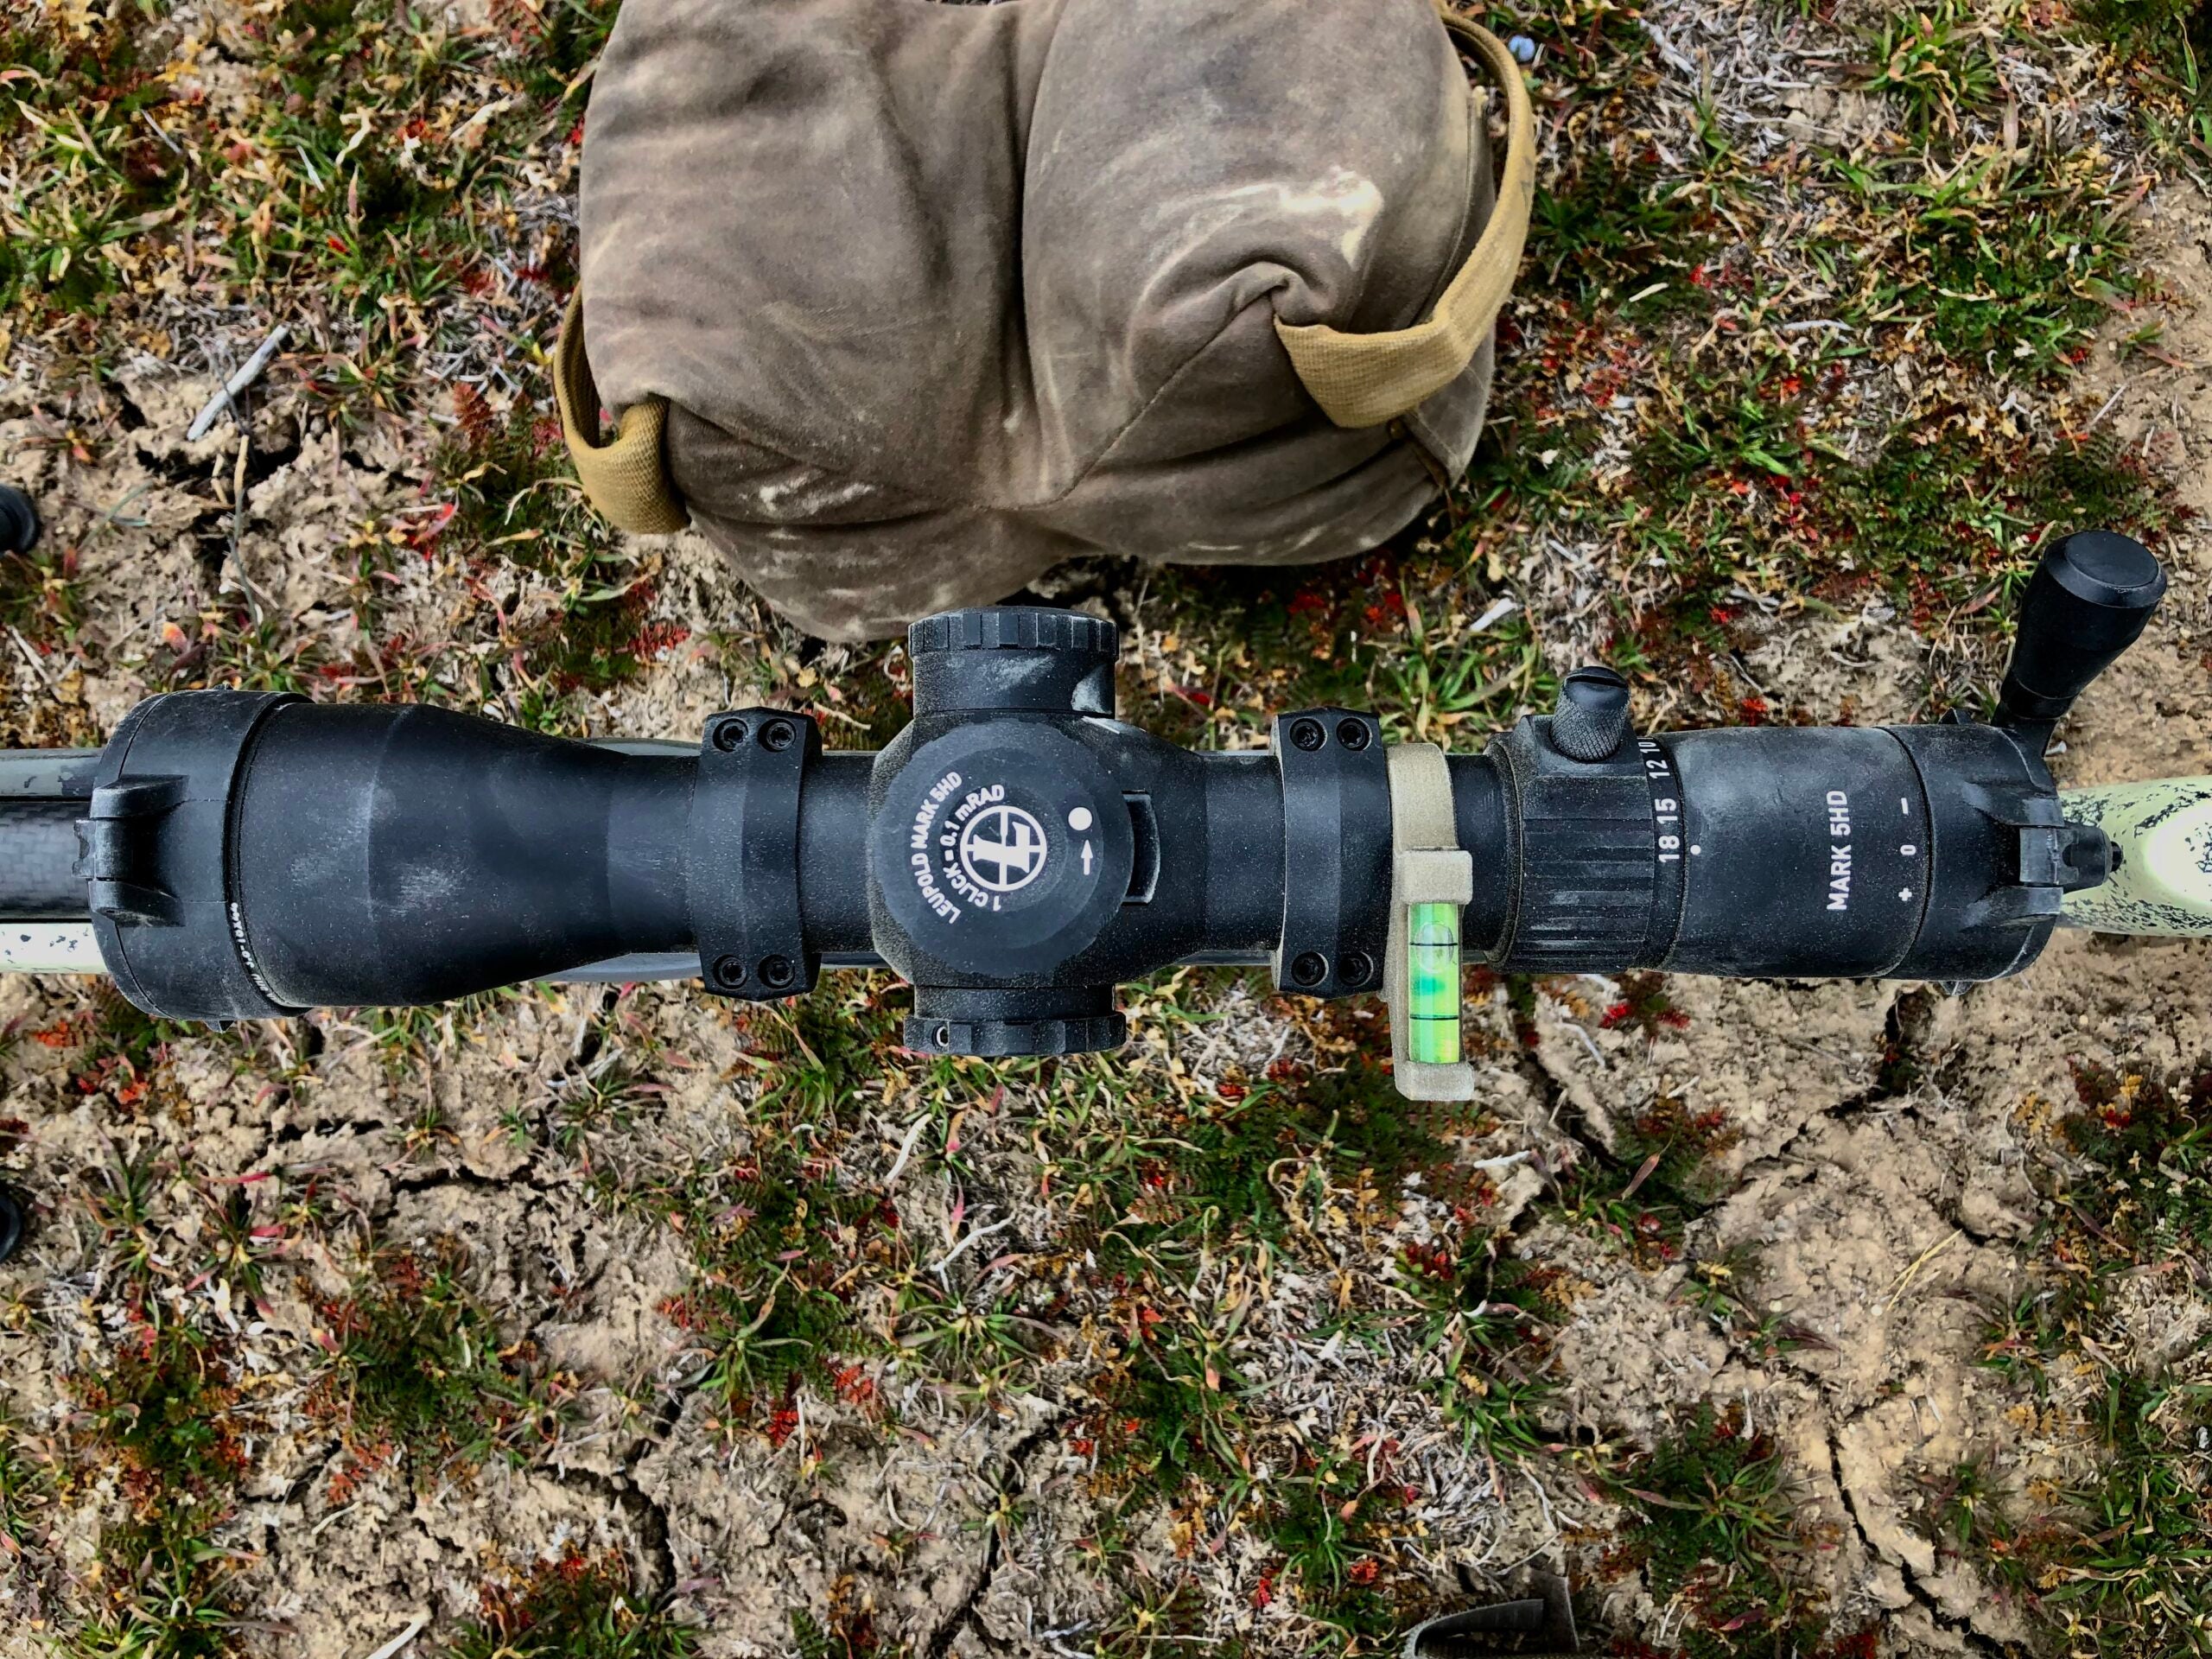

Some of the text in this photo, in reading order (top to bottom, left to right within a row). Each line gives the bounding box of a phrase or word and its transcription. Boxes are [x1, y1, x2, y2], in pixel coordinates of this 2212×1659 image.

[955, 784, 1005, 822] mRAD
[1637, 741, 1681, 863] 18 15 12 10
[911, 772, 963, 924] LEUPOLD MARK 5HD
[939, 820, 960, 847] 0.1
[1826, 790, 1853, 911] MARK 5HD
[1900, 844, 1916, 855] 0
[943, 861, 989, 908] CLICK
[993, 895, 1001, 912] 1
